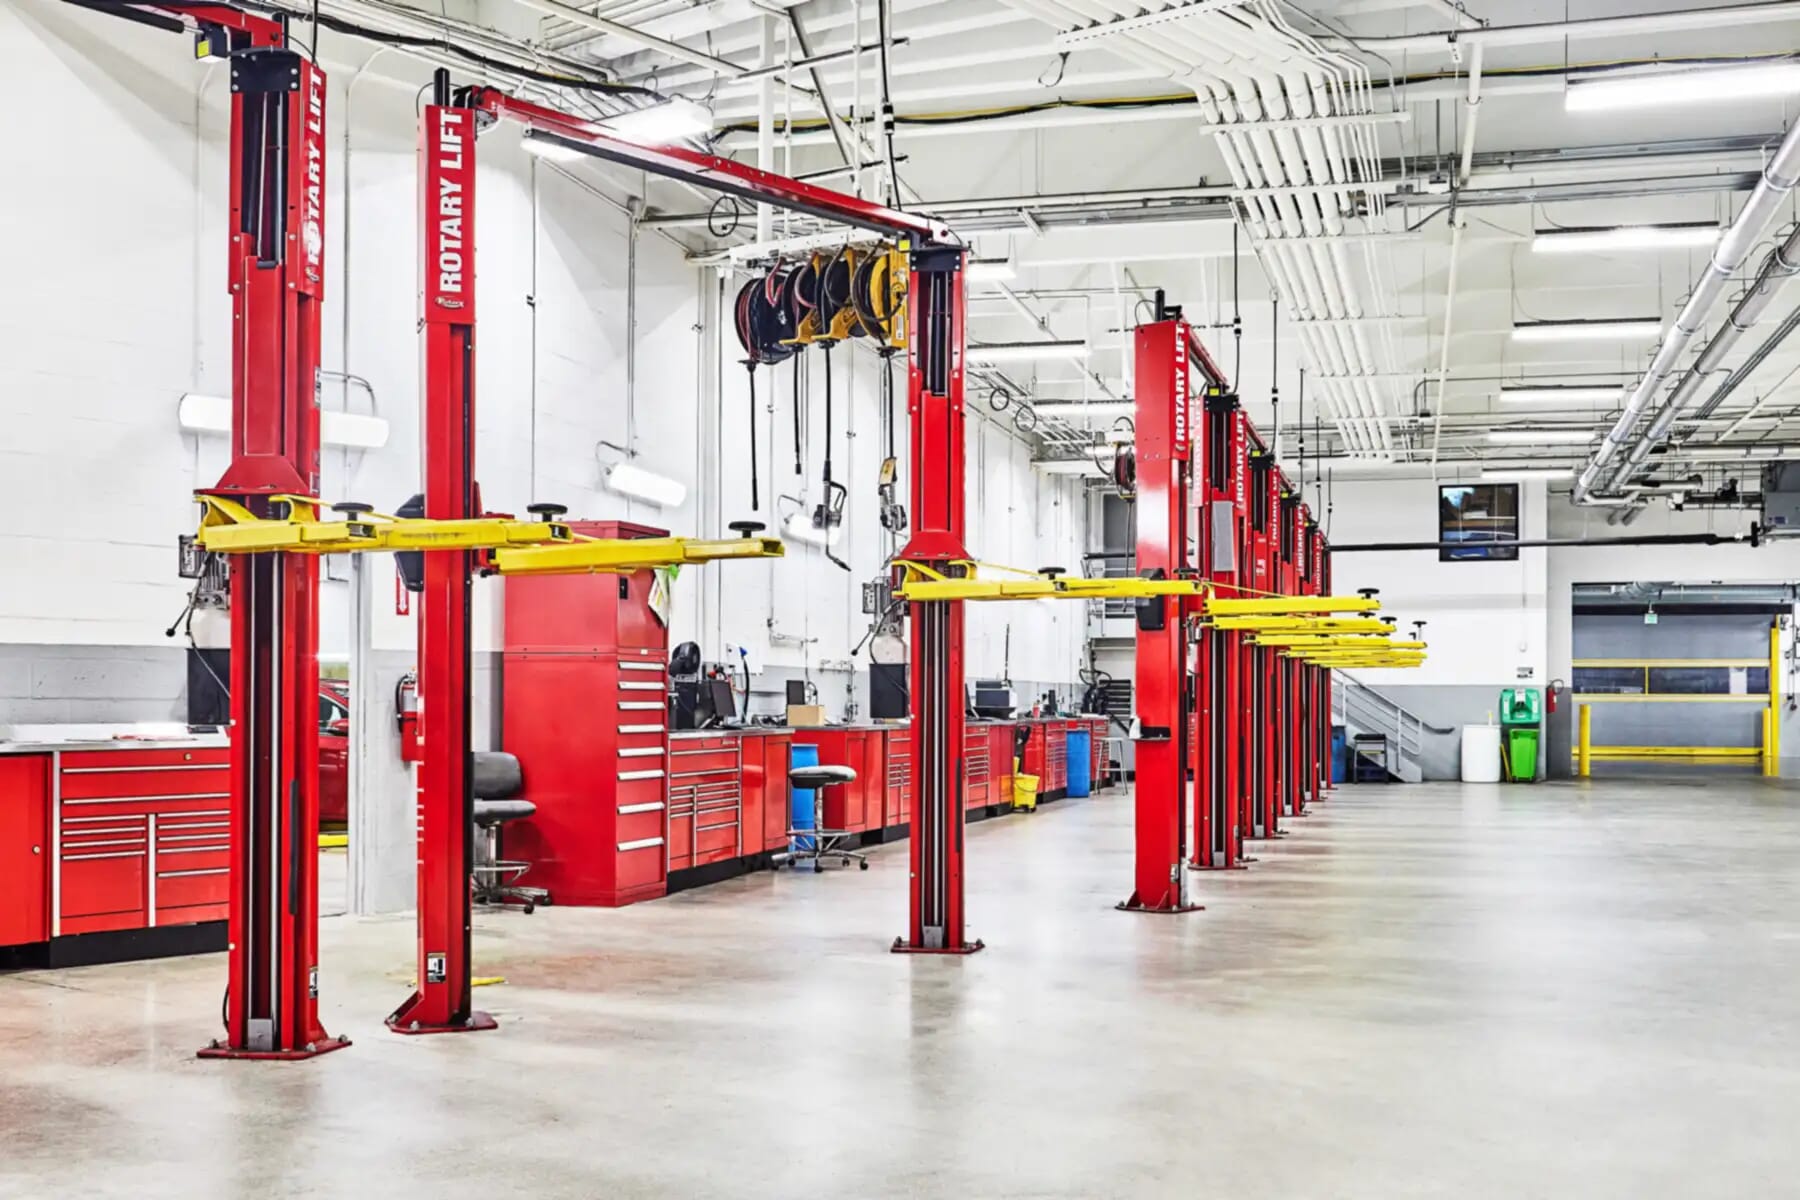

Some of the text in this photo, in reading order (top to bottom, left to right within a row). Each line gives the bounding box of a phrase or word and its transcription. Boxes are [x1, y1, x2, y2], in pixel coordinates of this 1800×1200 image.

[309, 67, 322, 134] LIFT
[308, 140, 321, 265] ROTARY
[440, 109, 462, 292] ROTARY LIFT
[1176, 324, 1185, 363] LIFT
[1176, 368, 1185, 441] ROTARY
